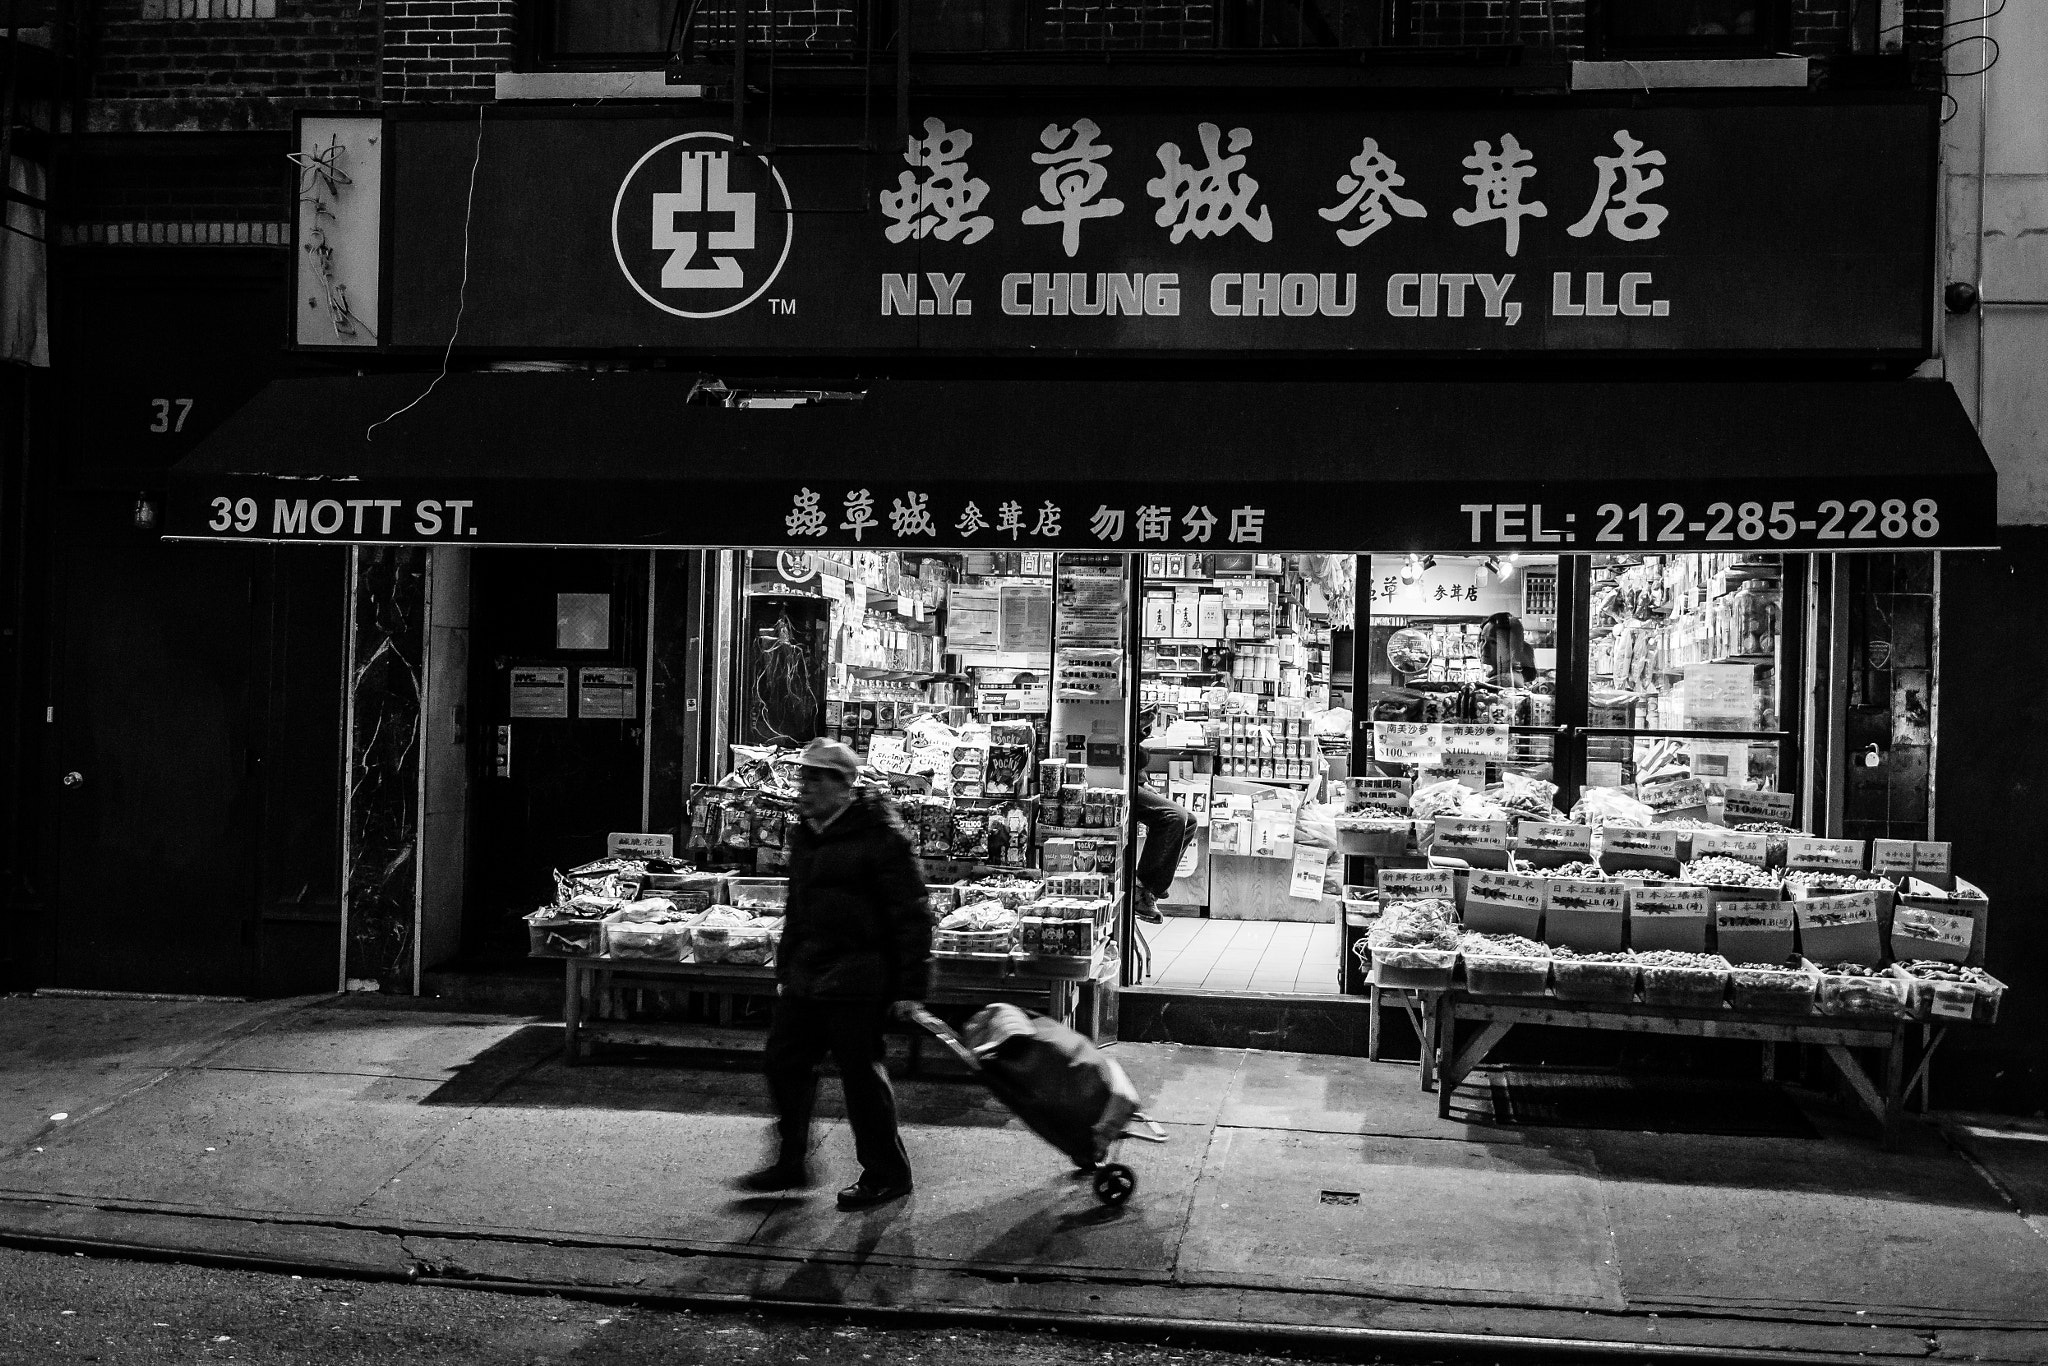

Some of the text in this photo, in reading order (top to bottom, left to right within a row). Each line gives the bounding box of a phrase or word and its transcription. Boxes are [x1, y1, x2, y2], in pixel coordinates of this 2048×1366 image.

[880, 117, 1272, 257] 蟲草城
[768, 299, 796, 314] TM
[881, 271, 1670, 326] N.Y. CHUNG CHOU CITY, LLC.
[150, 398, 193, 433] 37
[208, 496, 478, 536] 39 MOTT ST.
[785, 487, 936, 541] 蟲草城
[1090, 504, 1265, 543] 勿街分店
[1461, 498, 1940, 542] TEL: 212-285-2288
